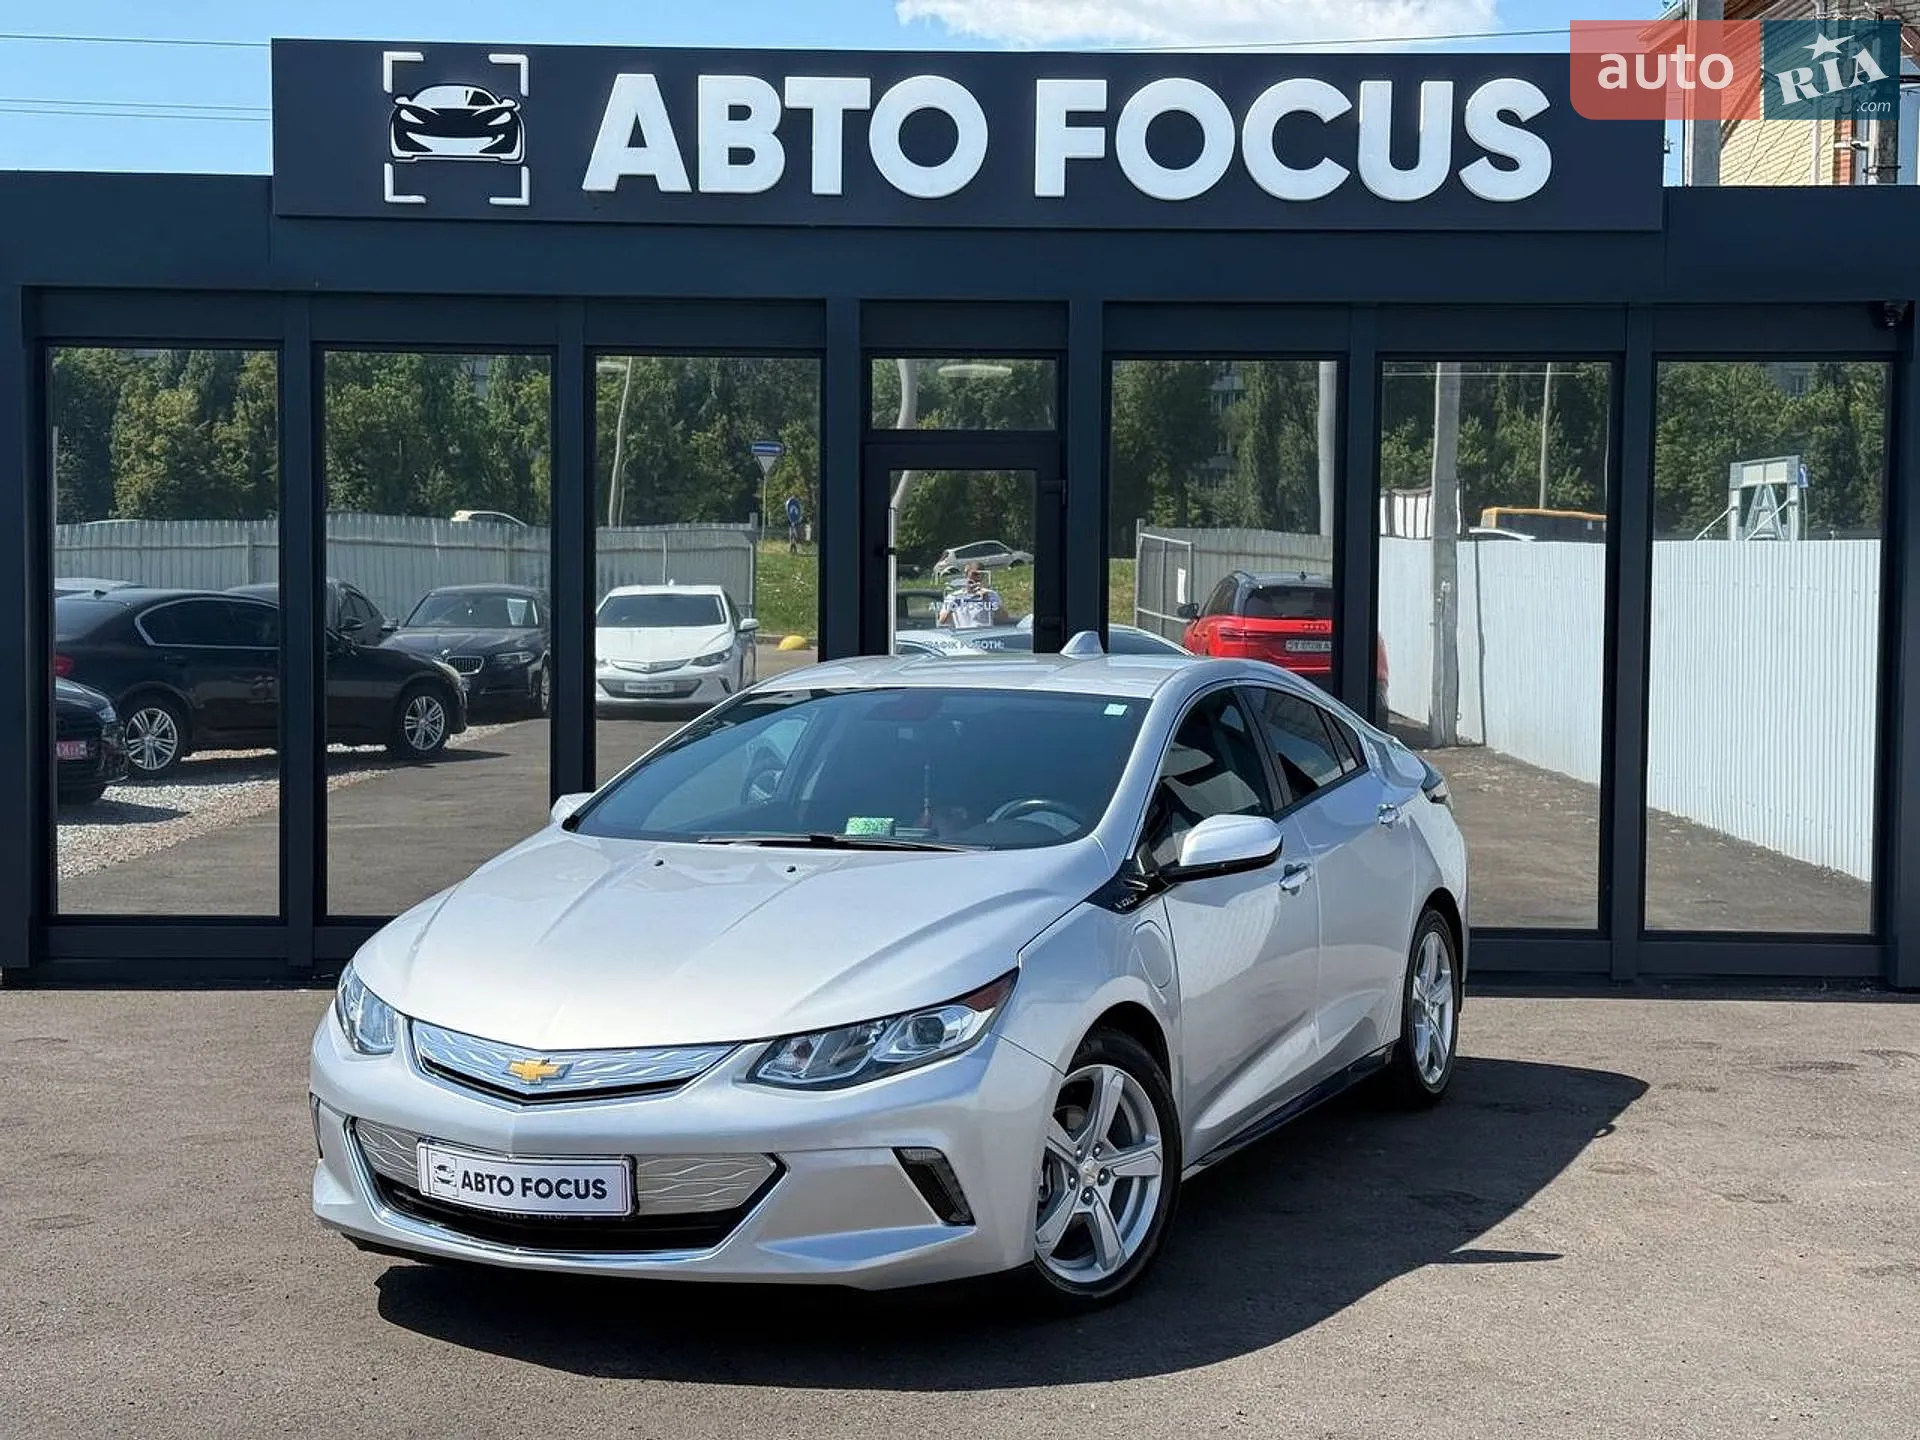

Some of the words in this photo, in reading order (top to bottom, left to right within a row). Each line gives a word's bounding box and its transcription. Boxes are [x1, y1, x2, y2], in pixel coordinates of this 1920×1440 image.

[582, 73, 989, 199] АВТО
[1034, 77, 1552, 202] FOCUS
[461, 1170, 514, 1197] АВТО
[521, 1177, 608, 1200] FOCUS
